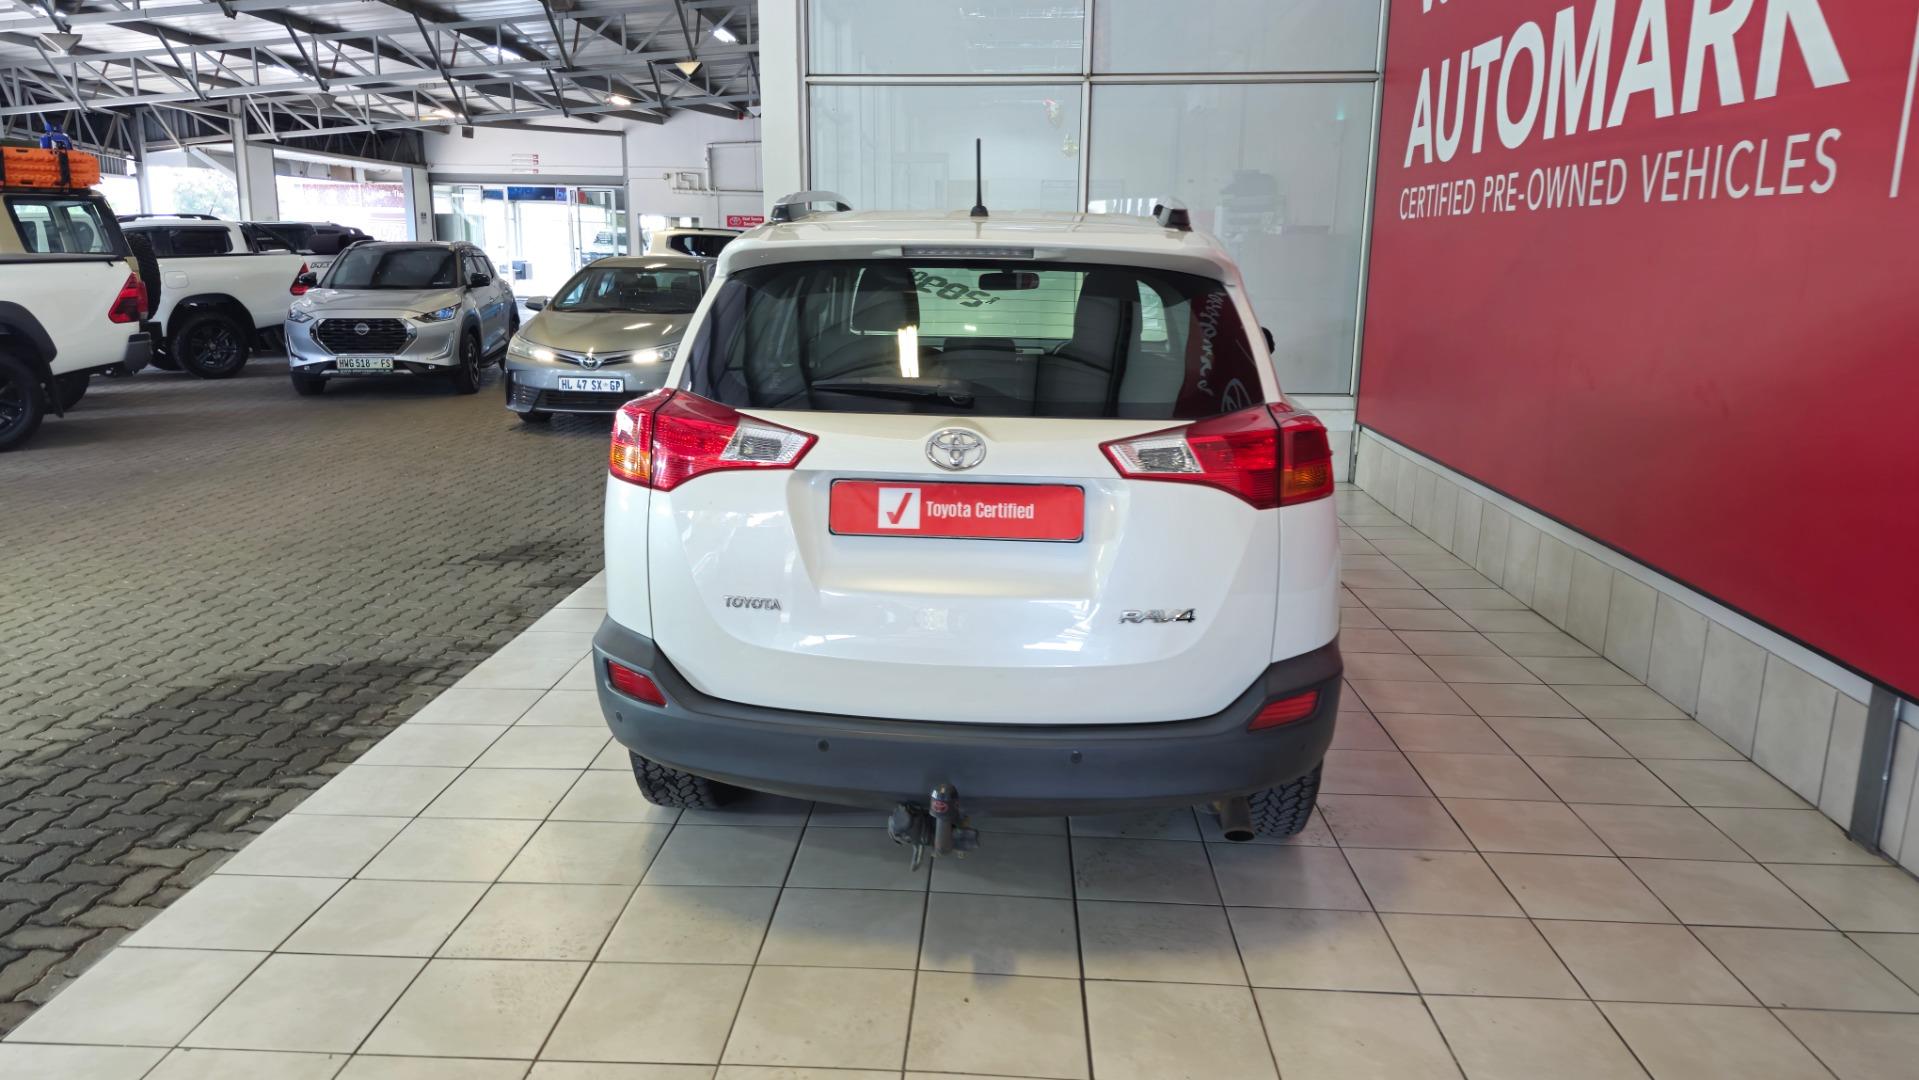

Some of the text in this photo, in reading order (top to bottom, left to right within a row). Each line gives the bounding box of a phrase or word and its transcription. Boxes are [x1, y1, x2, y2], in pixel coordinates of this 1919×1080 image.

[1400, 128, 1842, 220] CERTIFIED PRE-OWNED VEHICLES
[576, 379, 588, 390] 47
[591, 379, 603, 391] SX
[609, 380, 621, 391] GP
[926, 501, 1034, 519] Toyota Certified
[724, 596, 783, 611] TOYOTA
[1119, 608, 1196, 624] RAV4
